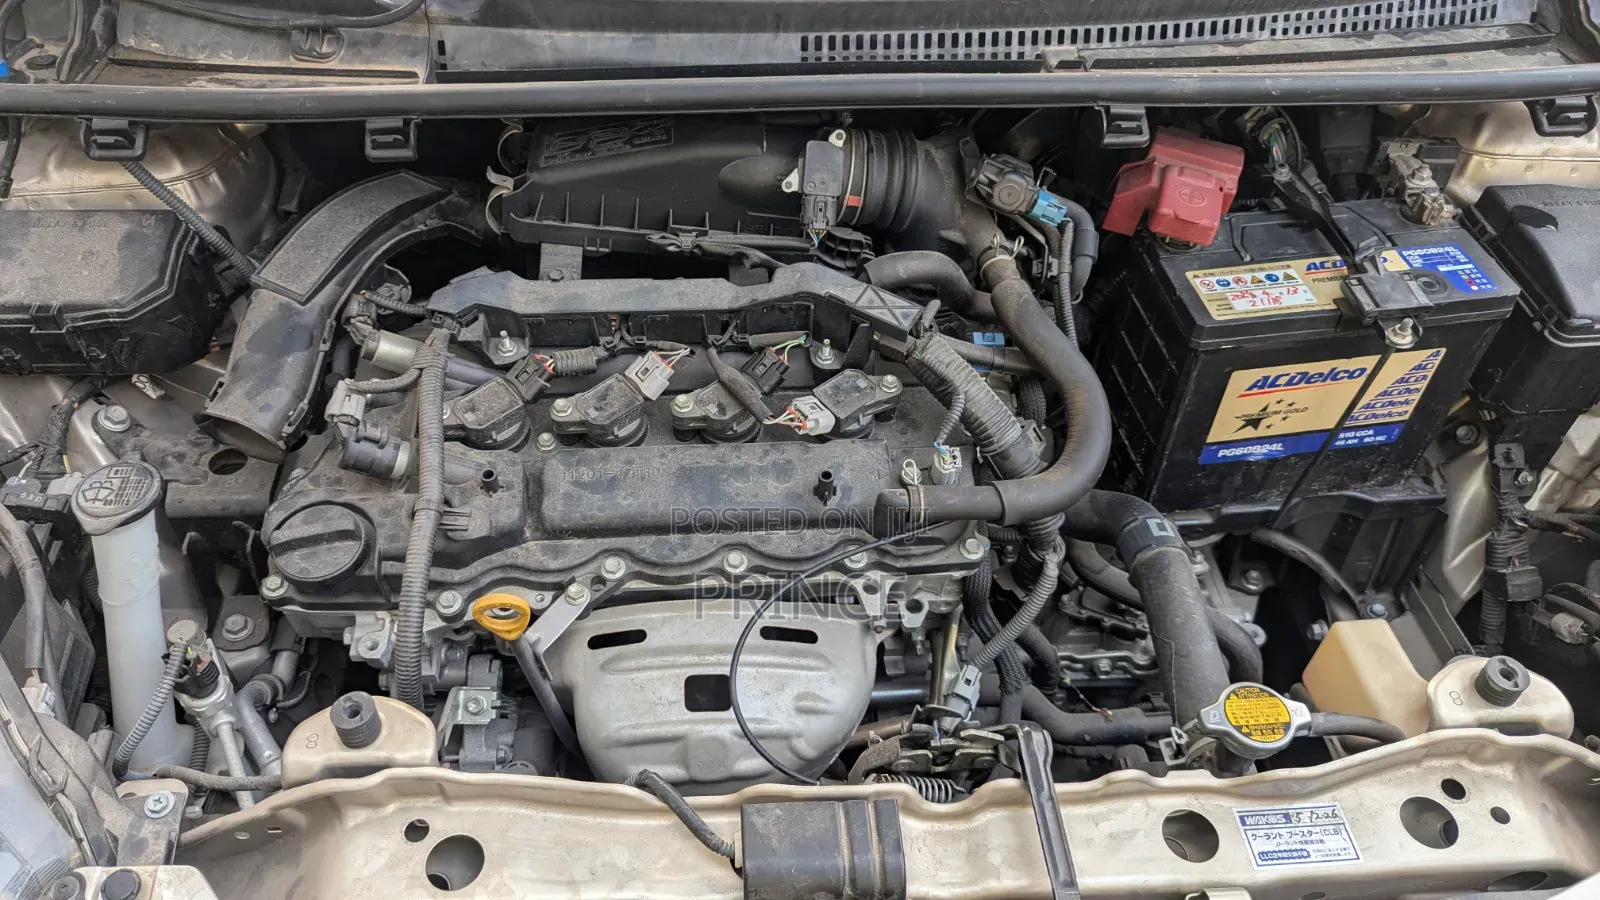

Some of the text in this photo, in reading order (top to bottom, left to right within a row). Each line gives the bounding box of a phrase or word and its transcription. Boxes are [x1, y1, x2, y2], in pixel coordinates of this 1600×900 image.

[31, 220, 68, 228] RELAY
[81, 220, 110, 228] FUSE
[1244, 366, 1368, 392] ACDelco
[1283, 406, 1309, 416] GOLD
[1217, 442, 1285, 458] PG60B24L
